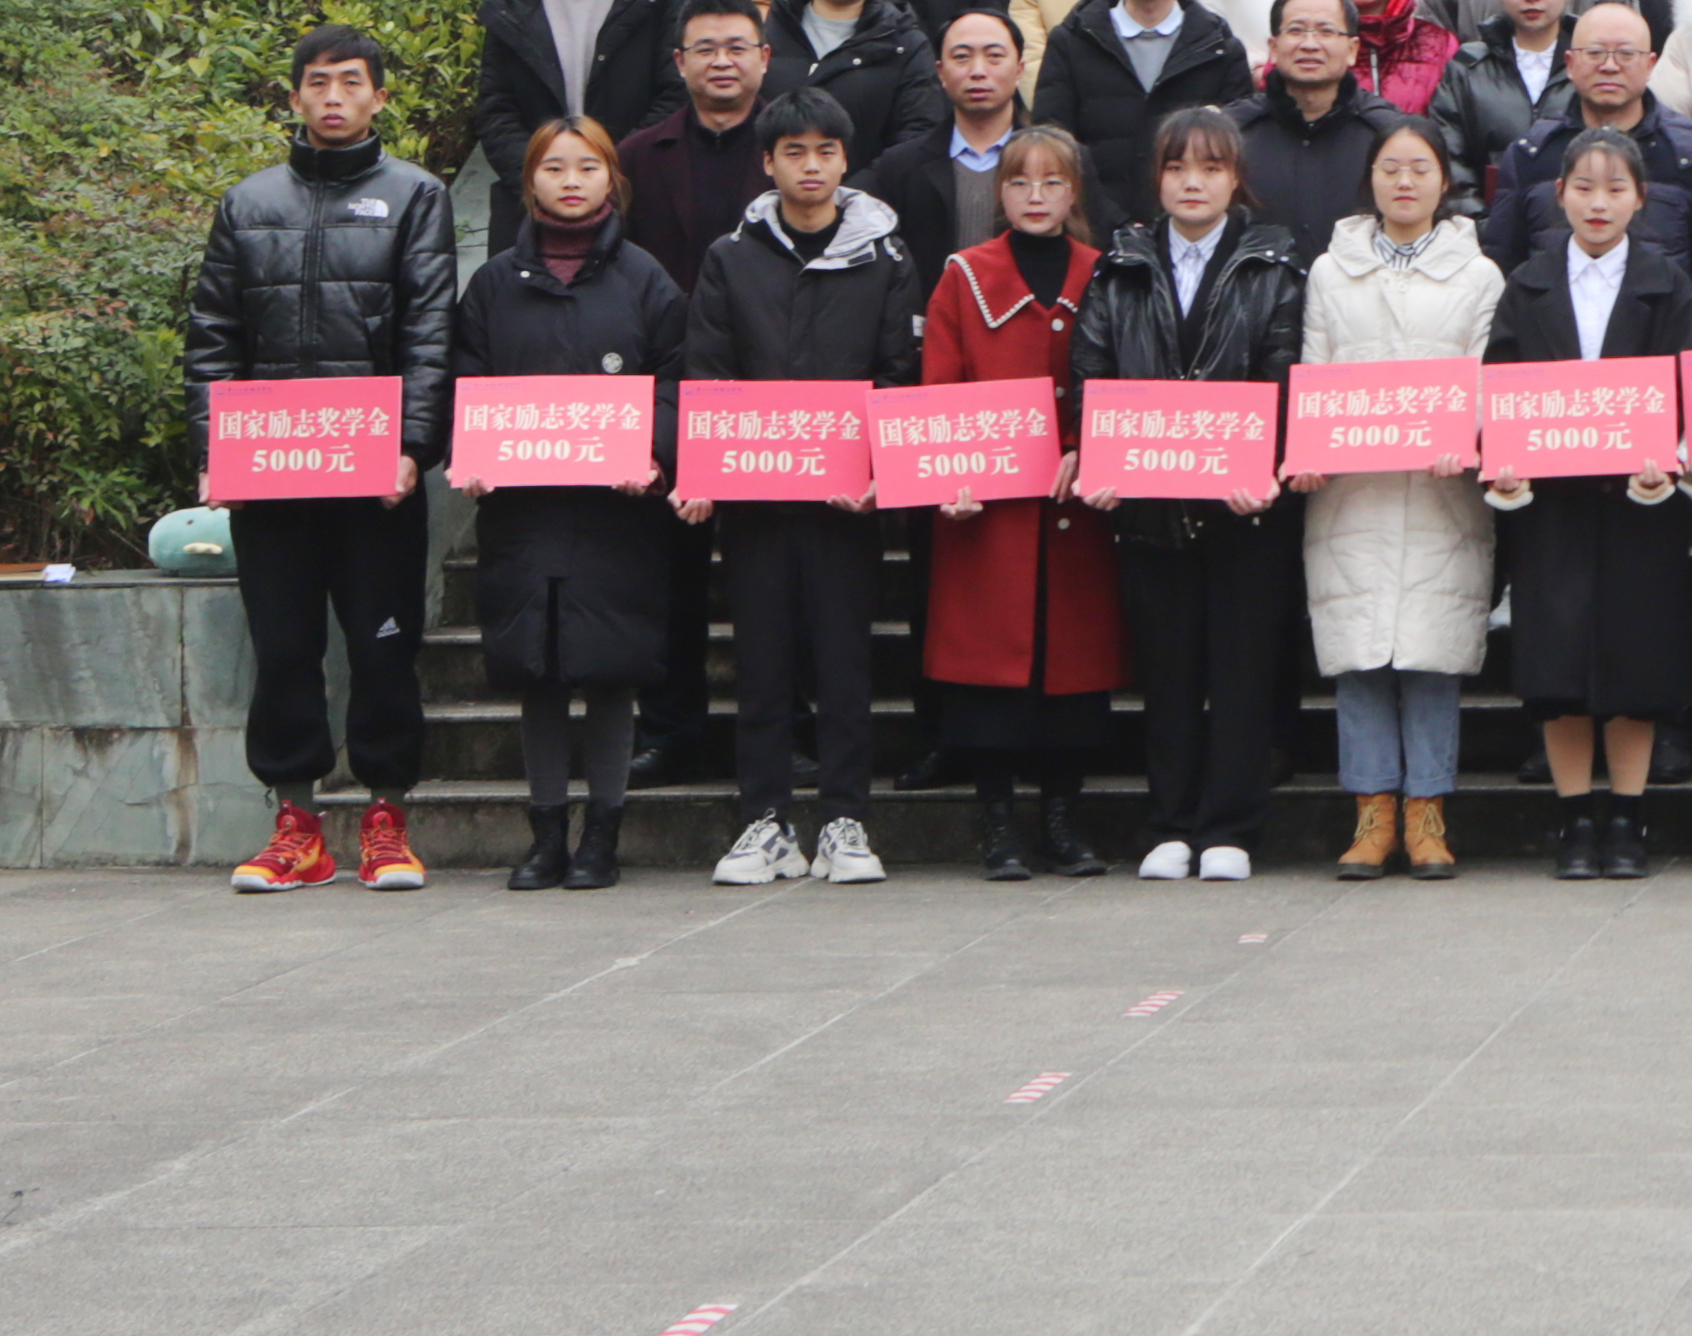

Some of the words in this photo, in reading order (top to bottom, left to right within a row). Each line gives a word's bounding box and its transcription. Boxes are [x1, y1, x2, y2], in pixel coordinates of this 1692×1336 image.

[1297, 384, 1468, 419] 国家励志奖学金
[1491, 385, 1665, 421] 国家励志奖学金
[219, 407, 390, 440] 国家励志奖学金
[464, 402, 641, 431] 国家励志奖学金
[688, 410, 861, 440] 国家励志奖学金
[879, 407, 1048, 448] 国家励志奖学金
[1091, 409, 1265, 440] 国家励志奖学金
[1329, 420, 1432, 448] 5000元
[1527, 422, 1633, 451] 5000元
[252, 444, 355, 473] 5000元
[498, 436, 605, 463] 5000元
[721, 447, 826, 476] 5000元
[918, 447, 1019, 478] 5000元
[1124, 447, 1229, 475] 5000元
